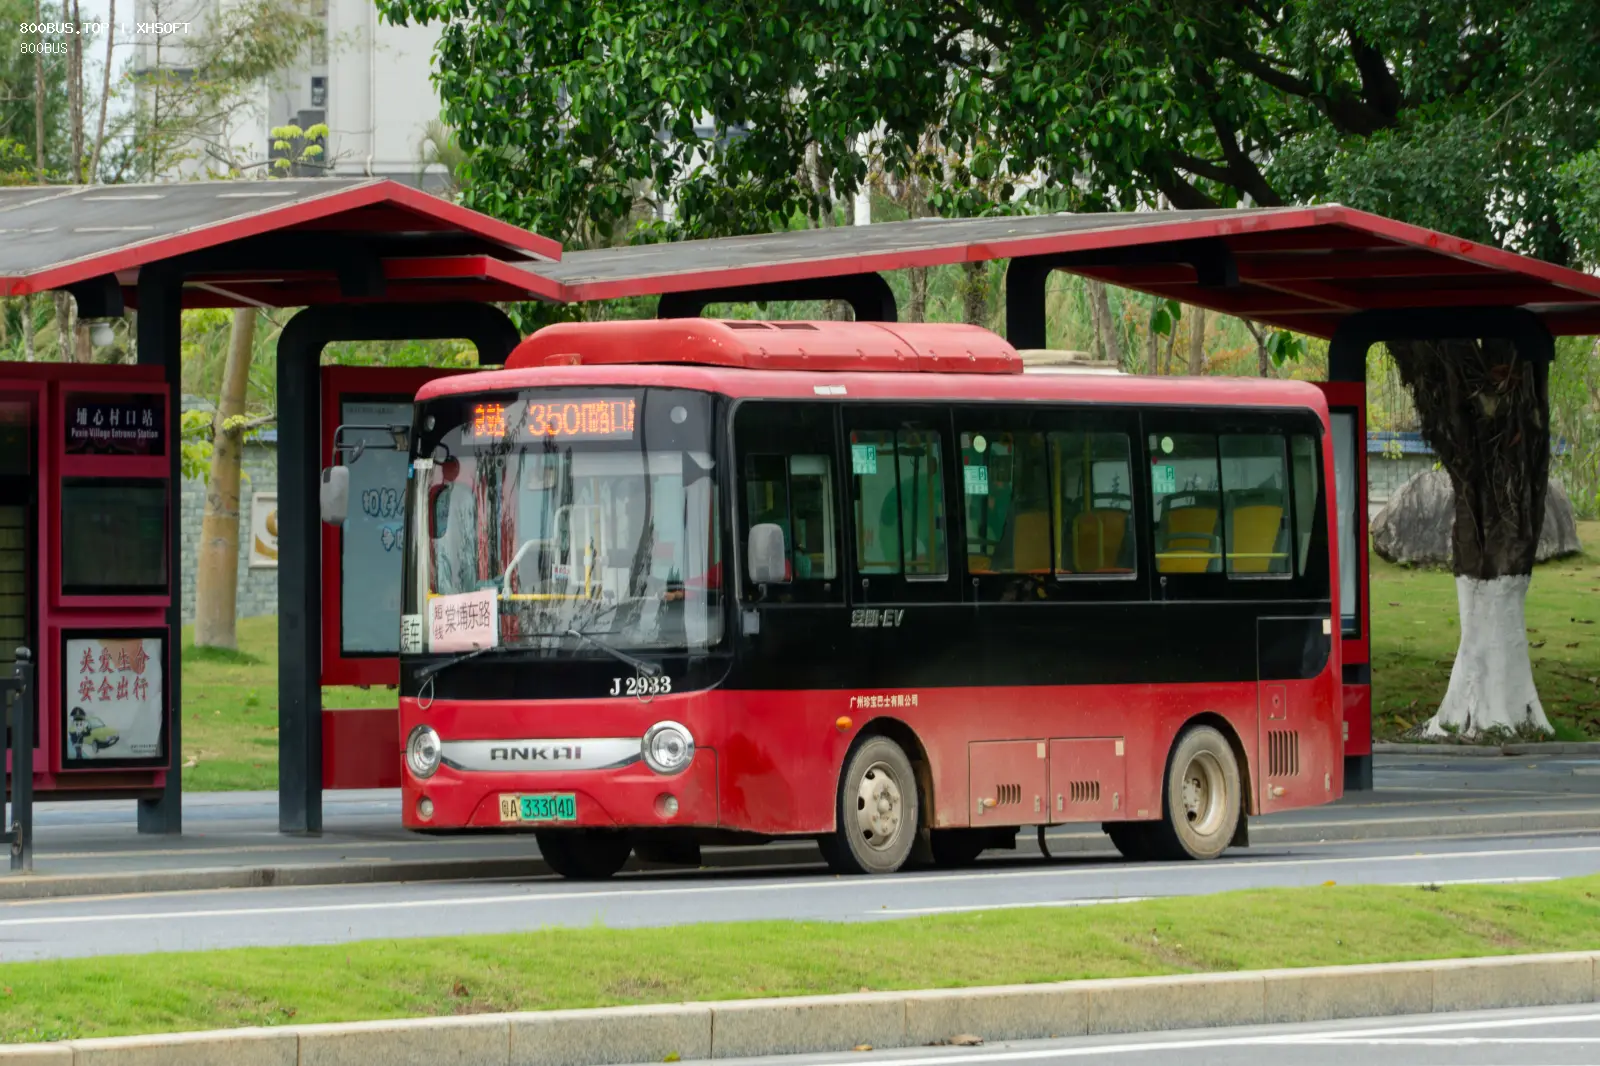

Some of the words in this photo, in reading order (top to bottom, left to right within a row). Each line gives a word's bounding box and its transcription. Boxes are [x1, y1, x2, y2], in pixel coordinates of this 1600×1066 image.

[76, 407, 153, 427] 埔心村口站
[89, 427, 111, 440] Village
[111, 427, 137, 438] Entrance
[137, 428, 159, 439] Station
[79, 645, 150, 675] 关爱生命
[78, 676, 149, 703] 安全出行
[625, 675, 672, 696] 2933
[849, 694, 918, 709] 广州珍宝巴士有限公司
[490, 746, 582, 760] ANKAI
